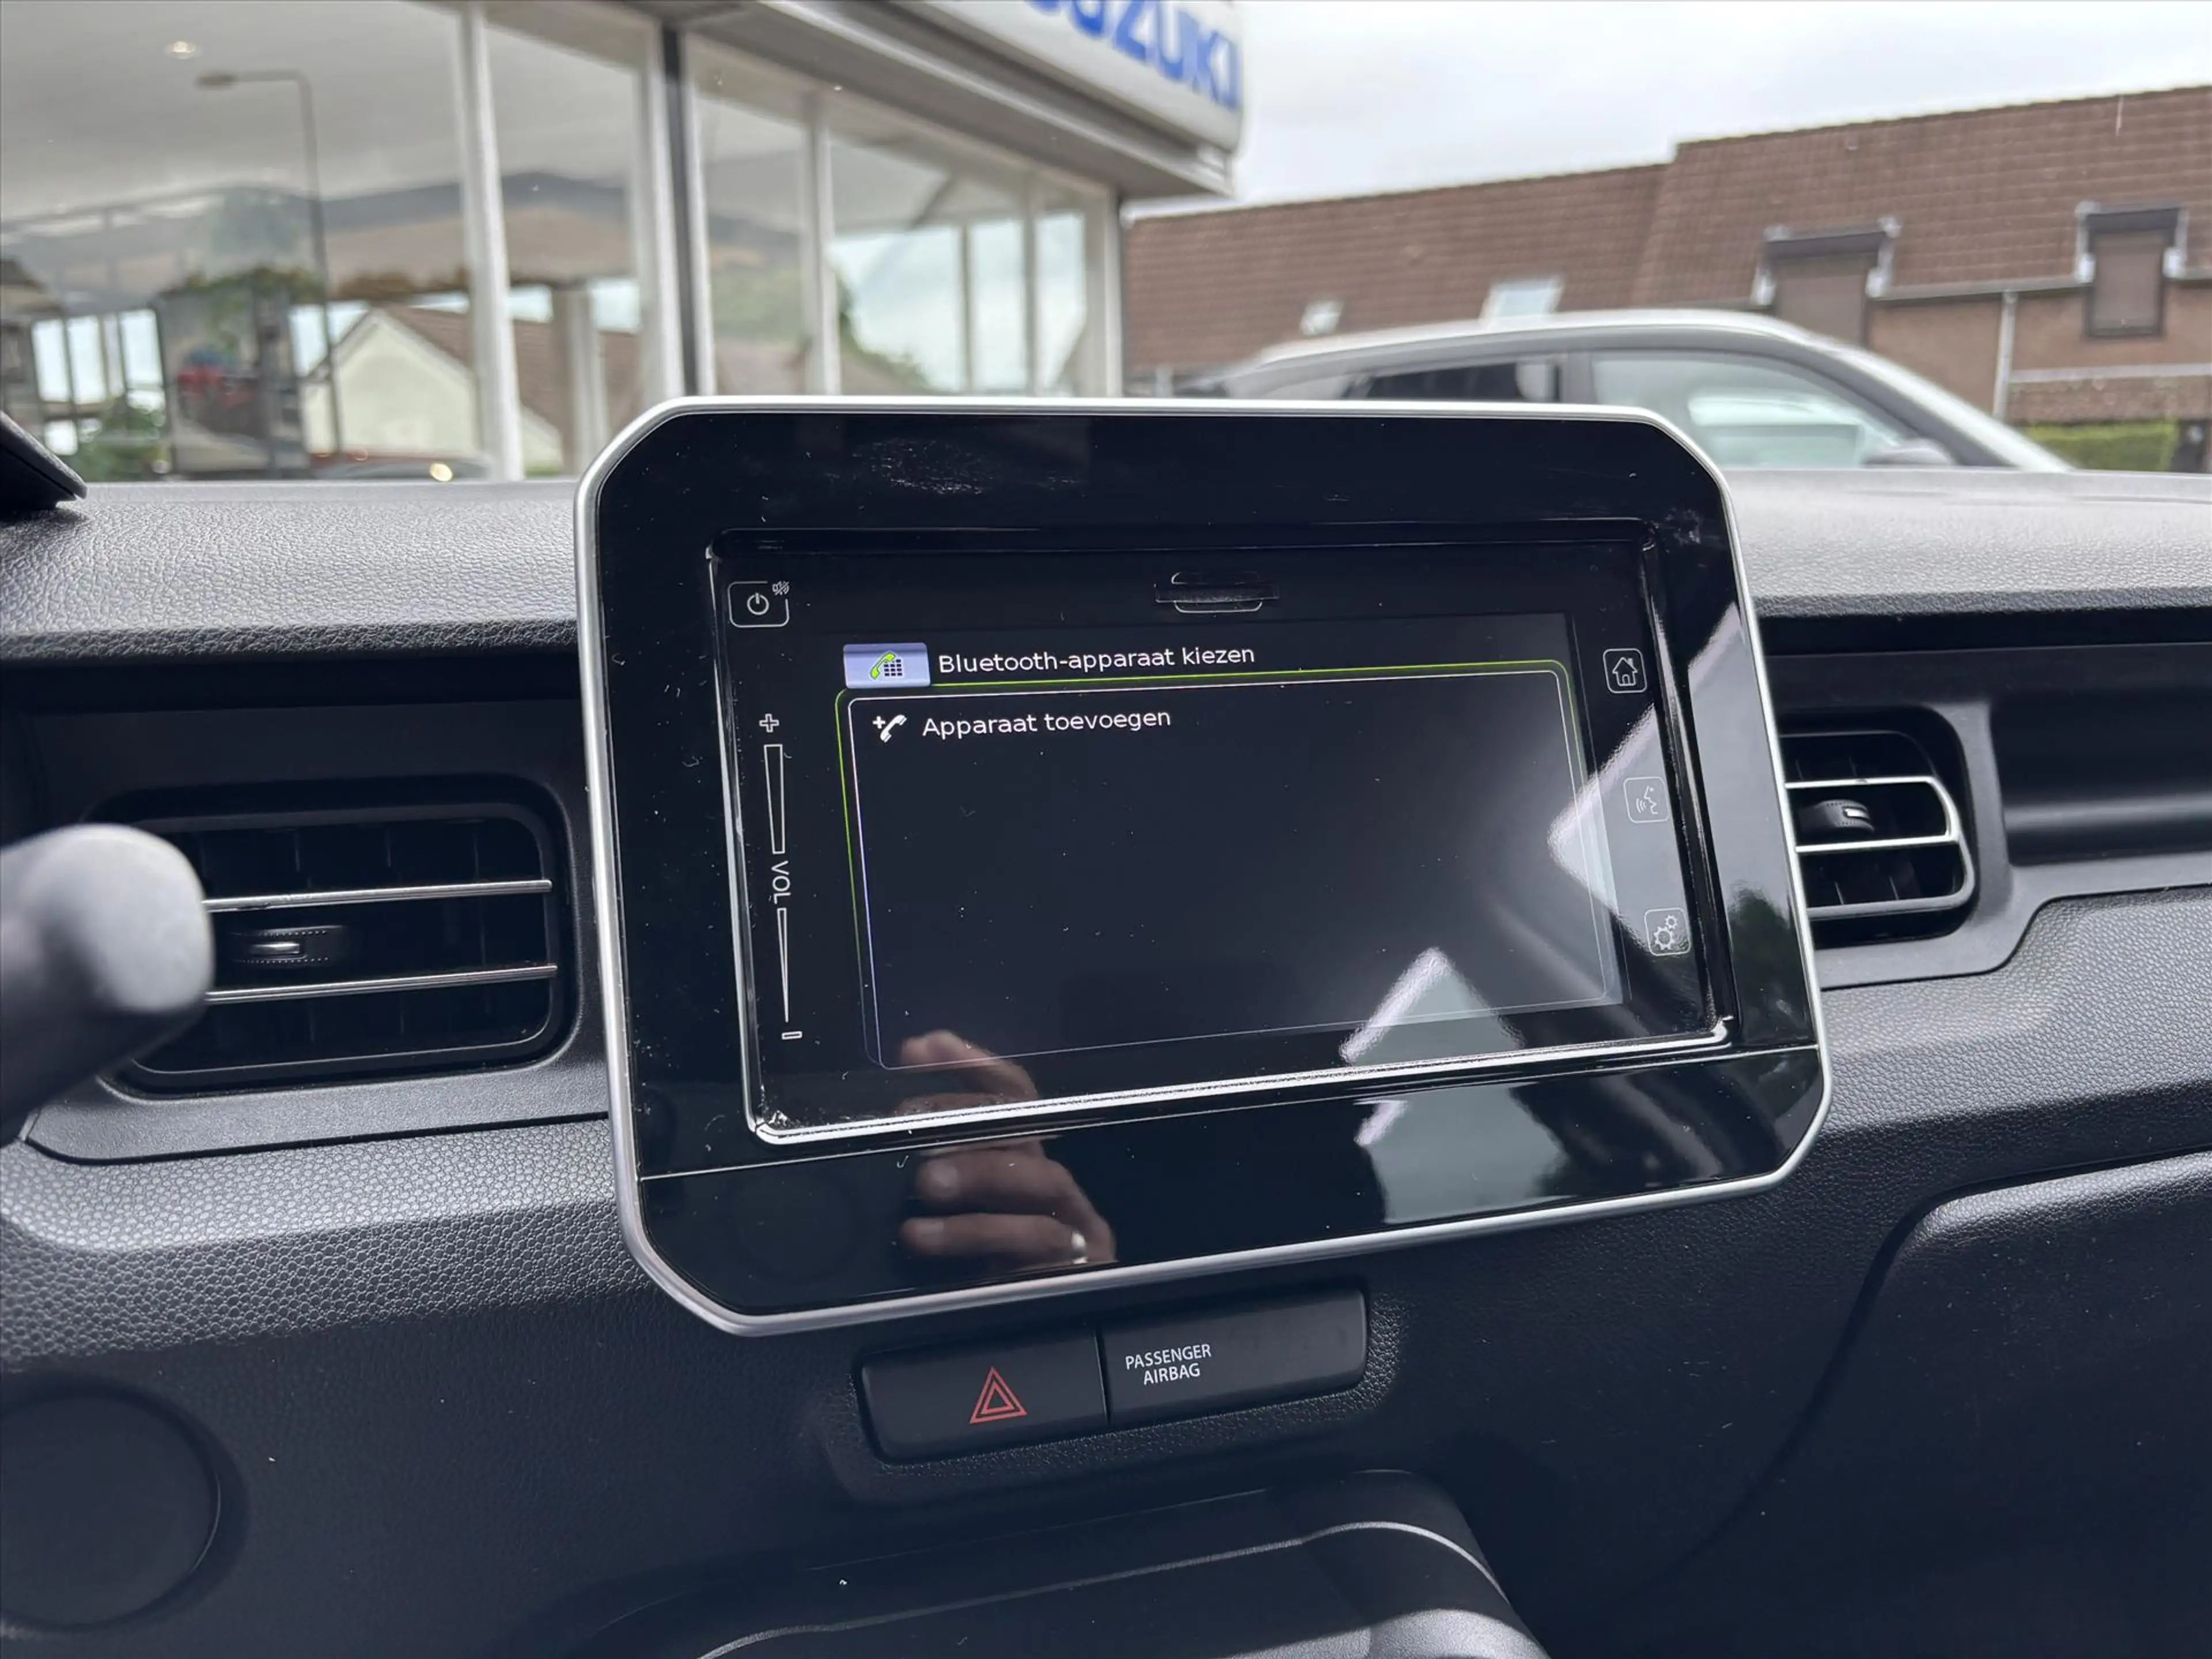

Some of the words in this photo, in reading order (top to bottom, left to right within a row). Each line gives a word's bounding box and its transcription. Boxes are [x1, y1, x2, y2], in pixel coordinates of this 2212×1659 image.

[1025, 0, 1240, 109] UZUKI
[938, 648, 1175, 673] Bluetooth-apparaat
[1181, 646, 1255, 665] kiezen
[922, 714, 1038, 739] Apparaat
[1043, 711, 1171, 732] toevoegen
[771, 860, 791, 904] VOL
[1125, 1343, 1212, 1370] PASSENGER
[1143, 1362, 1200, 1386] AIRBAG
